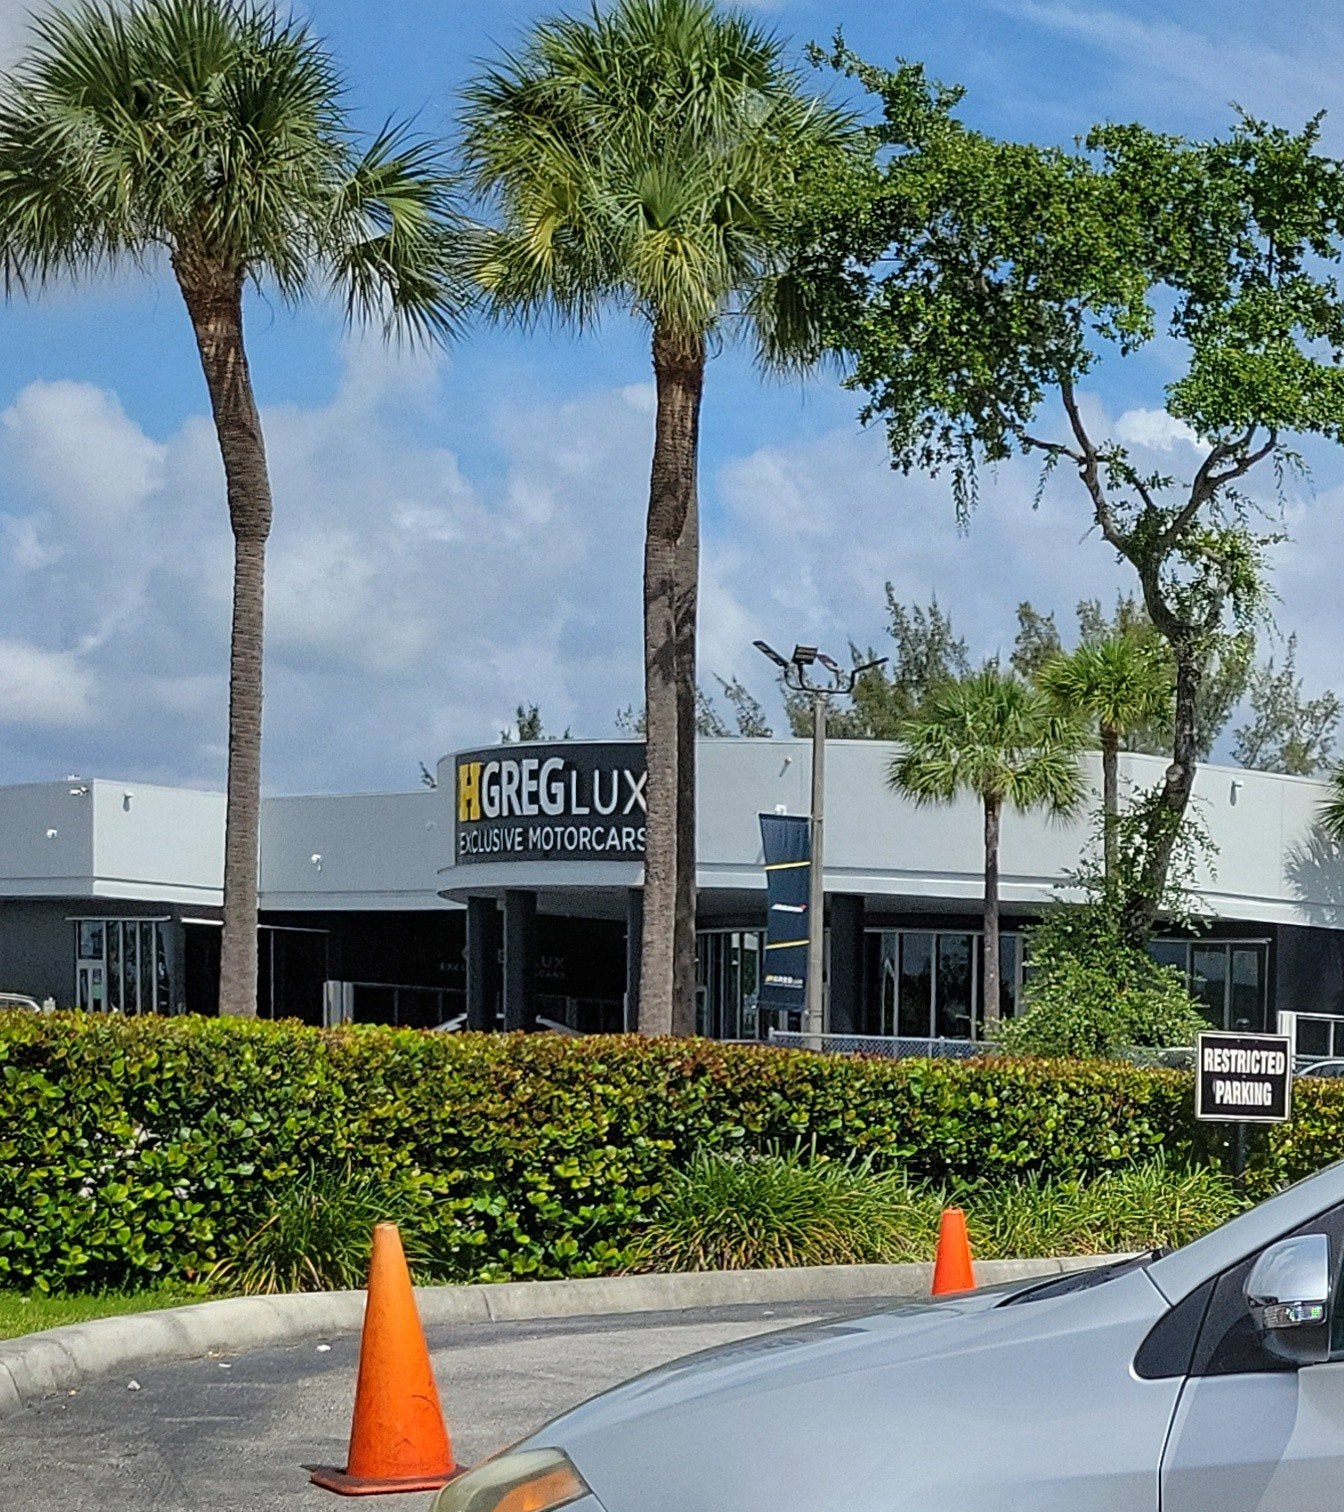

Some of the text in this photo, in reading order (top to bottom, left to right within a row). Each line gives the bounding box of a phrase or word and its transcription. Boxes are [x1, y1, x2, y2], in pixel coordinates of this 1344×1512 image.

[459, 826, 646, 855] EXCLUSIVE MOTORCARS
[1203, 1047, 1285, 1075] RESTRICTED
[1215, 1080, 1272, 1106] PARKING
